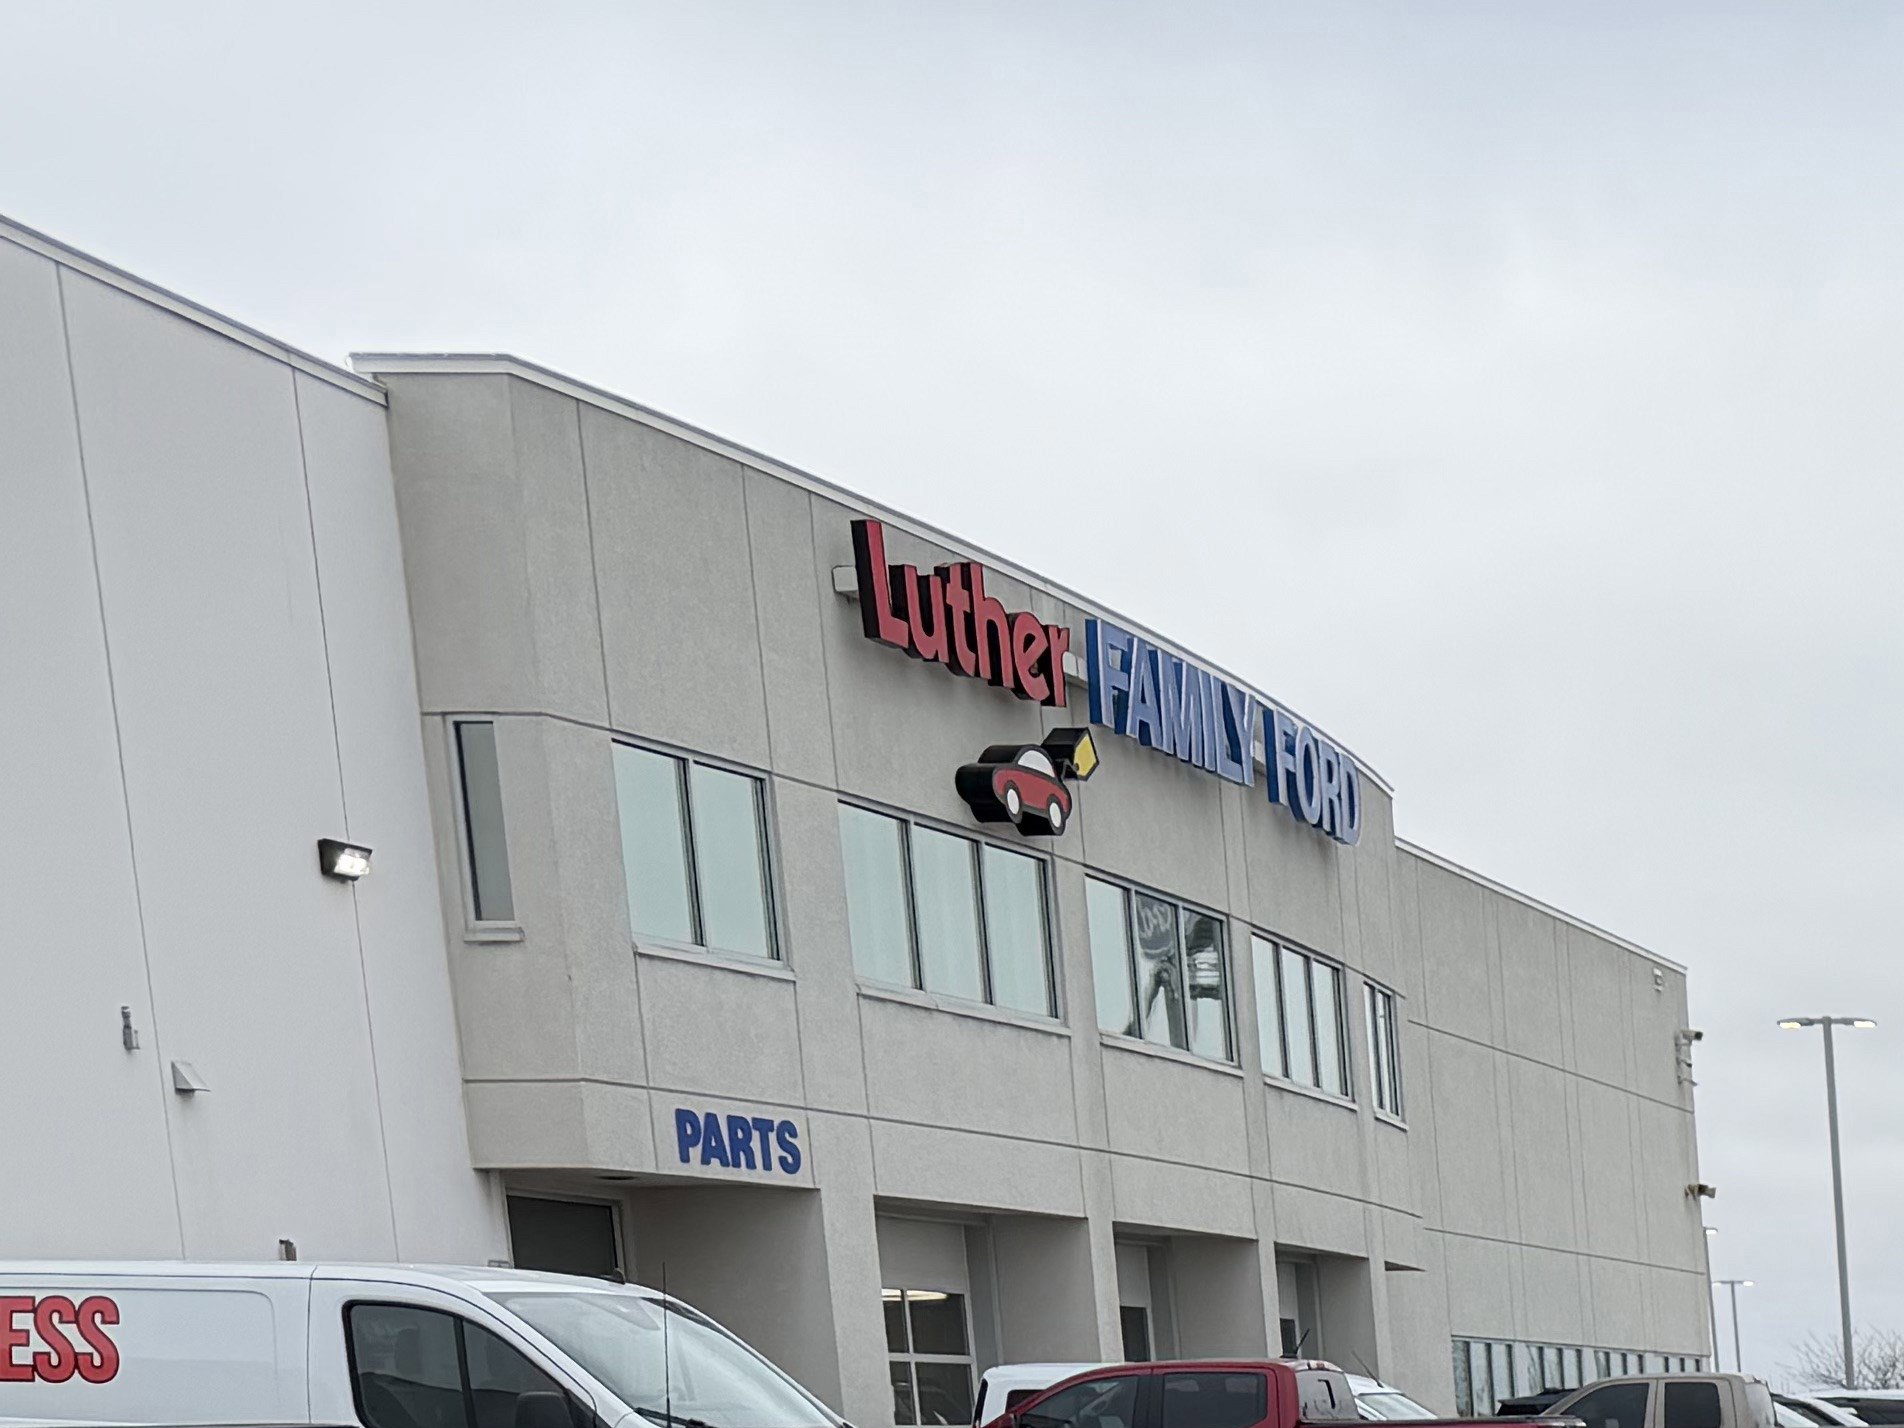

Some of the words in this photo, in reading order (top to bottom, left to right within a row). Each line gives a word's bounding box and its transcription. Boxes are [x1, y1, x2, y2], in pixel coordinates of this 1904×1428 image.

[852, 519, 1070, 708] Luther
[1085, 618, 1257, 788] FAMILY
[1263, 708, 1362, 847] FORD
[674, 1107, 802, 1175] PARTS
[0, 1294, 121, 1384] ESS
